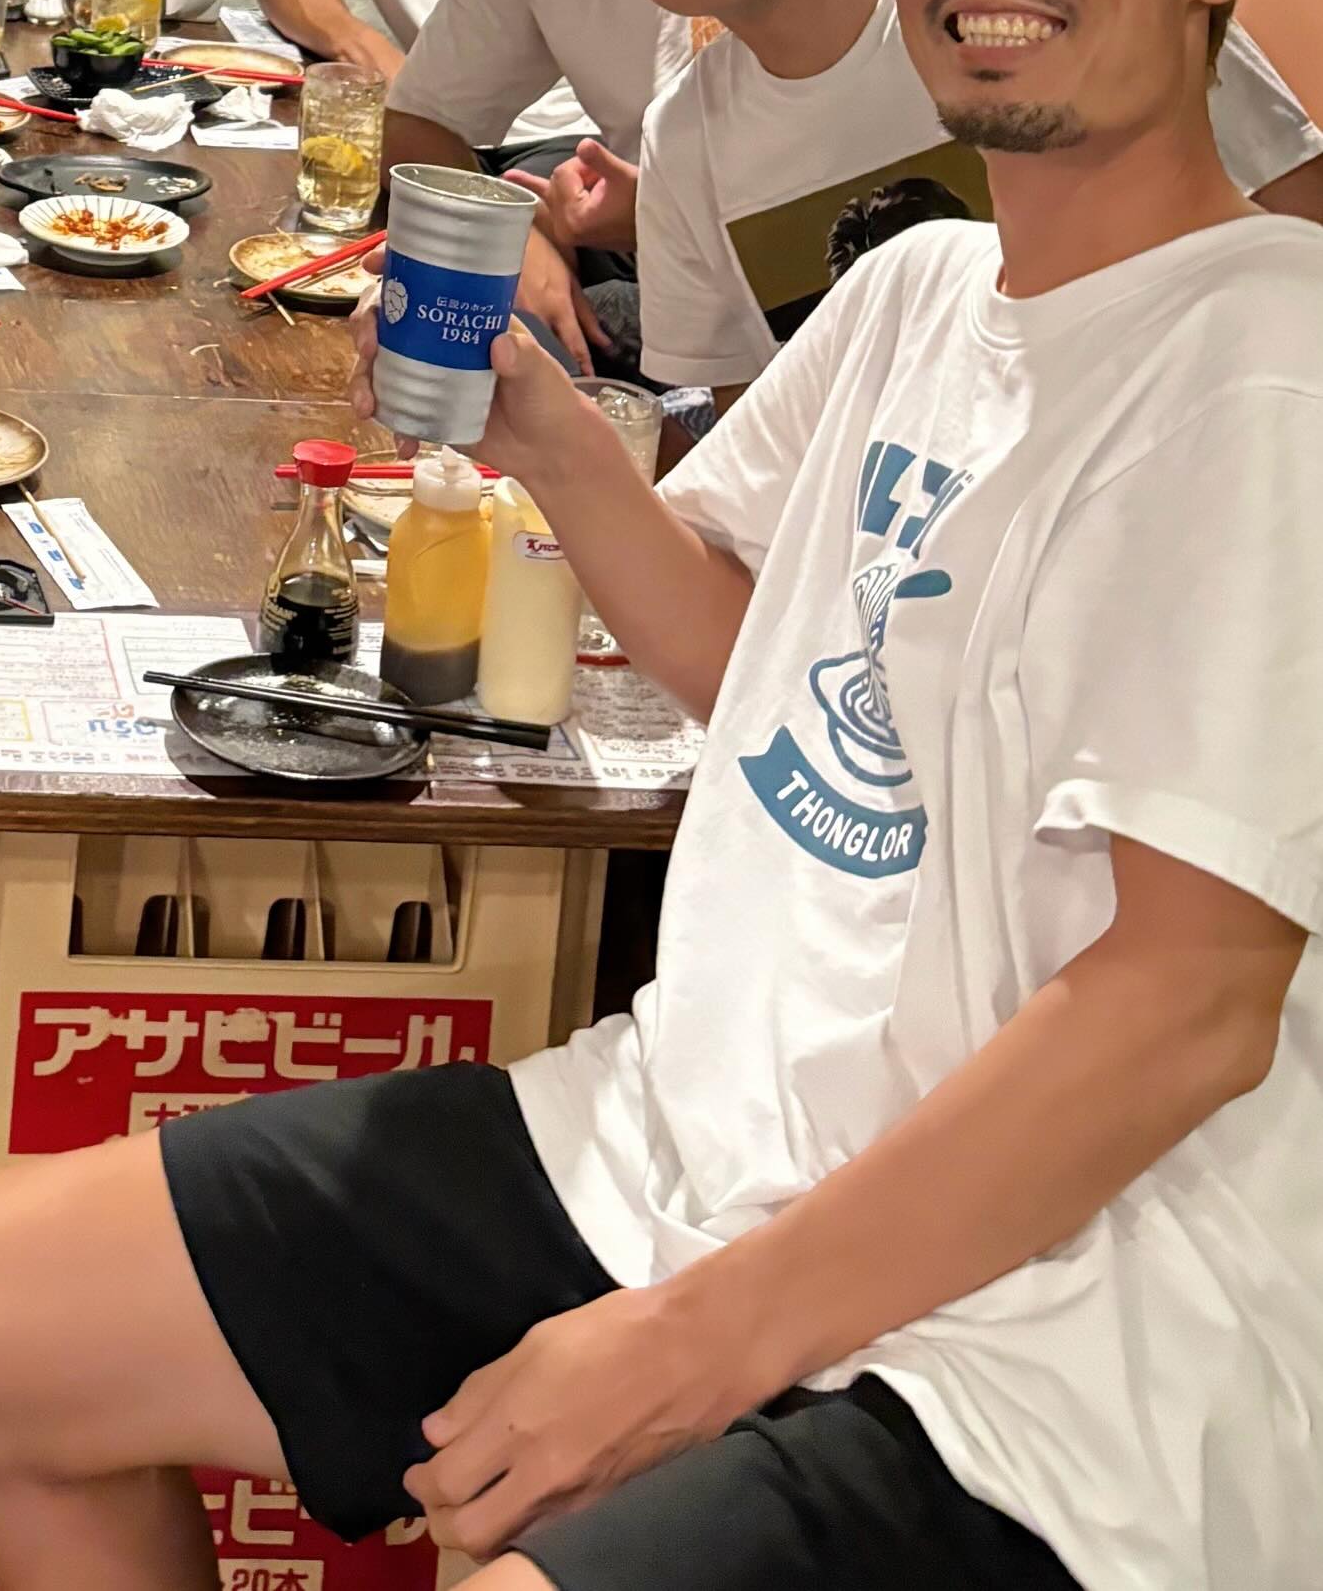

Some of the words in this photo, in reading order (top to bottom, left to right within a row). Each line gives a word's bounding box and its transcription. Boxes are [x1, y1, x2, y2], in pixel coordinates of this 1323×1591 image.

[417, 304, 504, 332] SORACHI
[436, 296, 495, 313] 伝説のホップ
[441, 327, 481, 346] 1984
[776, 769, 911, 862] THONGLOR
[33, 1006, 477, 1080] アサヒビール
